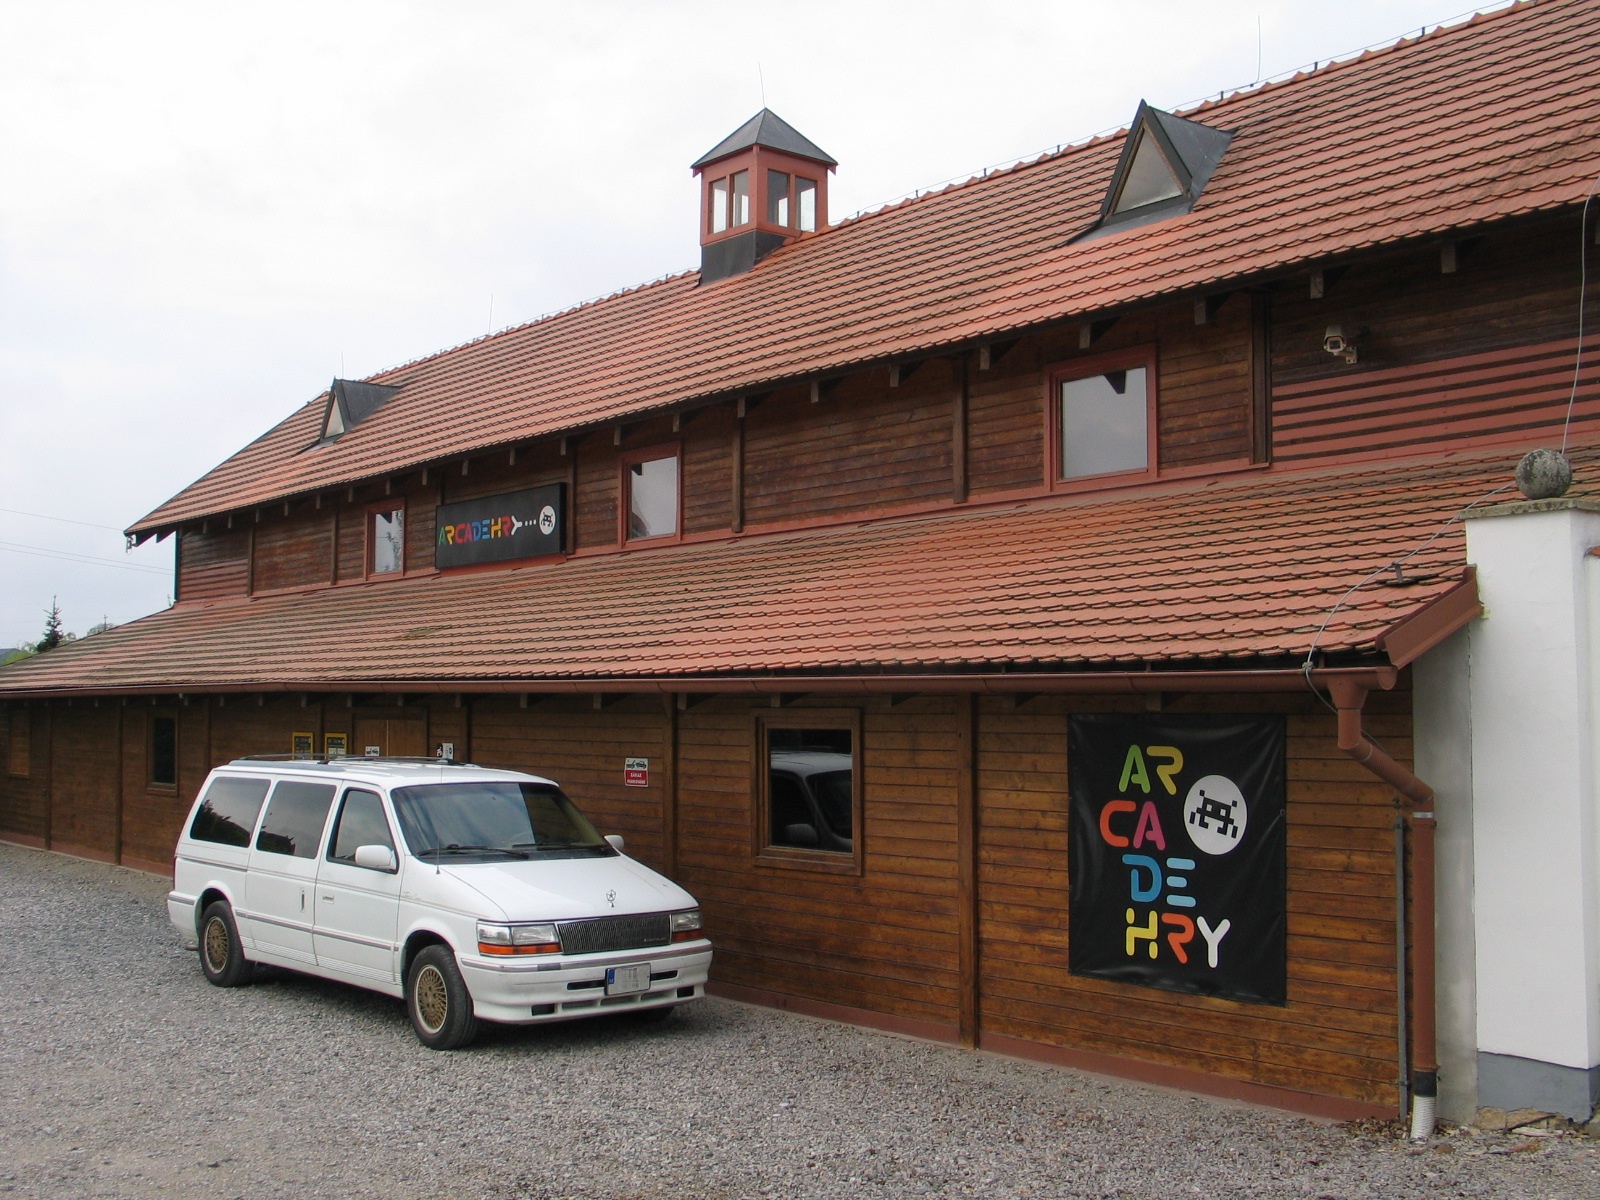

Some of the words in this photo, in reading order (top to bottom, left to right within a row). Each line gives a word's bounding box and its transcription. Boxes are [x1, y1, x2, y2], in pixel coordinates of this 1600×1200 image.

[1118, 744, 1184, 796] AR
[1099, 800, 1166, 850] CA
[1121, 853, 1197, 908] DE
[1125, 907, 1231, 969] HRY
